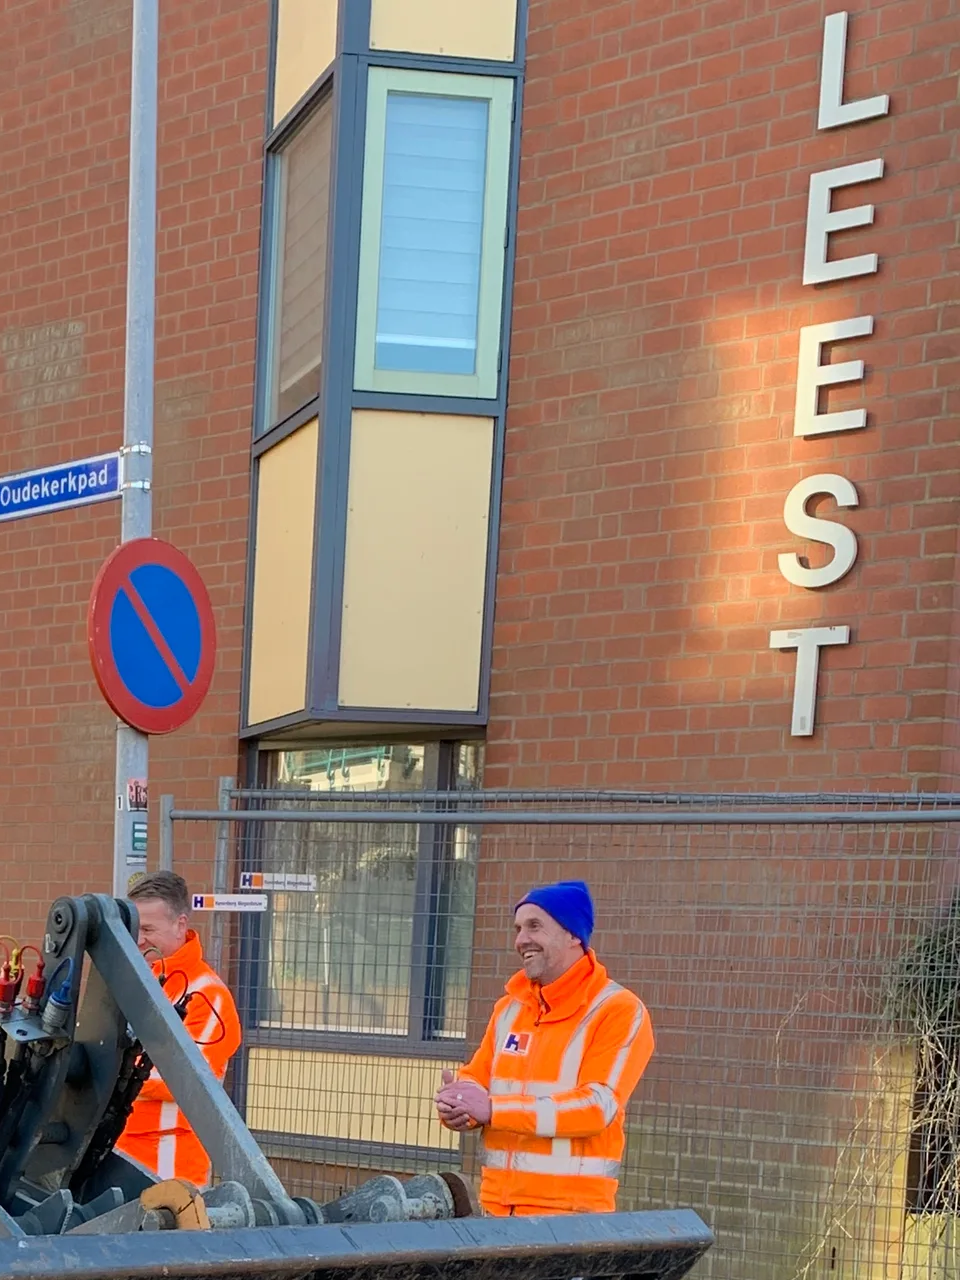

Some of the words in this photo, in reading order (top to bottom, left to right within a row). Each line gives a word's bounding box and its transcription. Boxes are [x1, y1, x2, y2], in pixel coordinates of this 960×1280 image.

[769, 10, 890, 737] LEEST
[0, 464, 108, 506] Oudekerkpad
[193, 896, 204, 908] H
[505, 1034, 519, 1051] H
